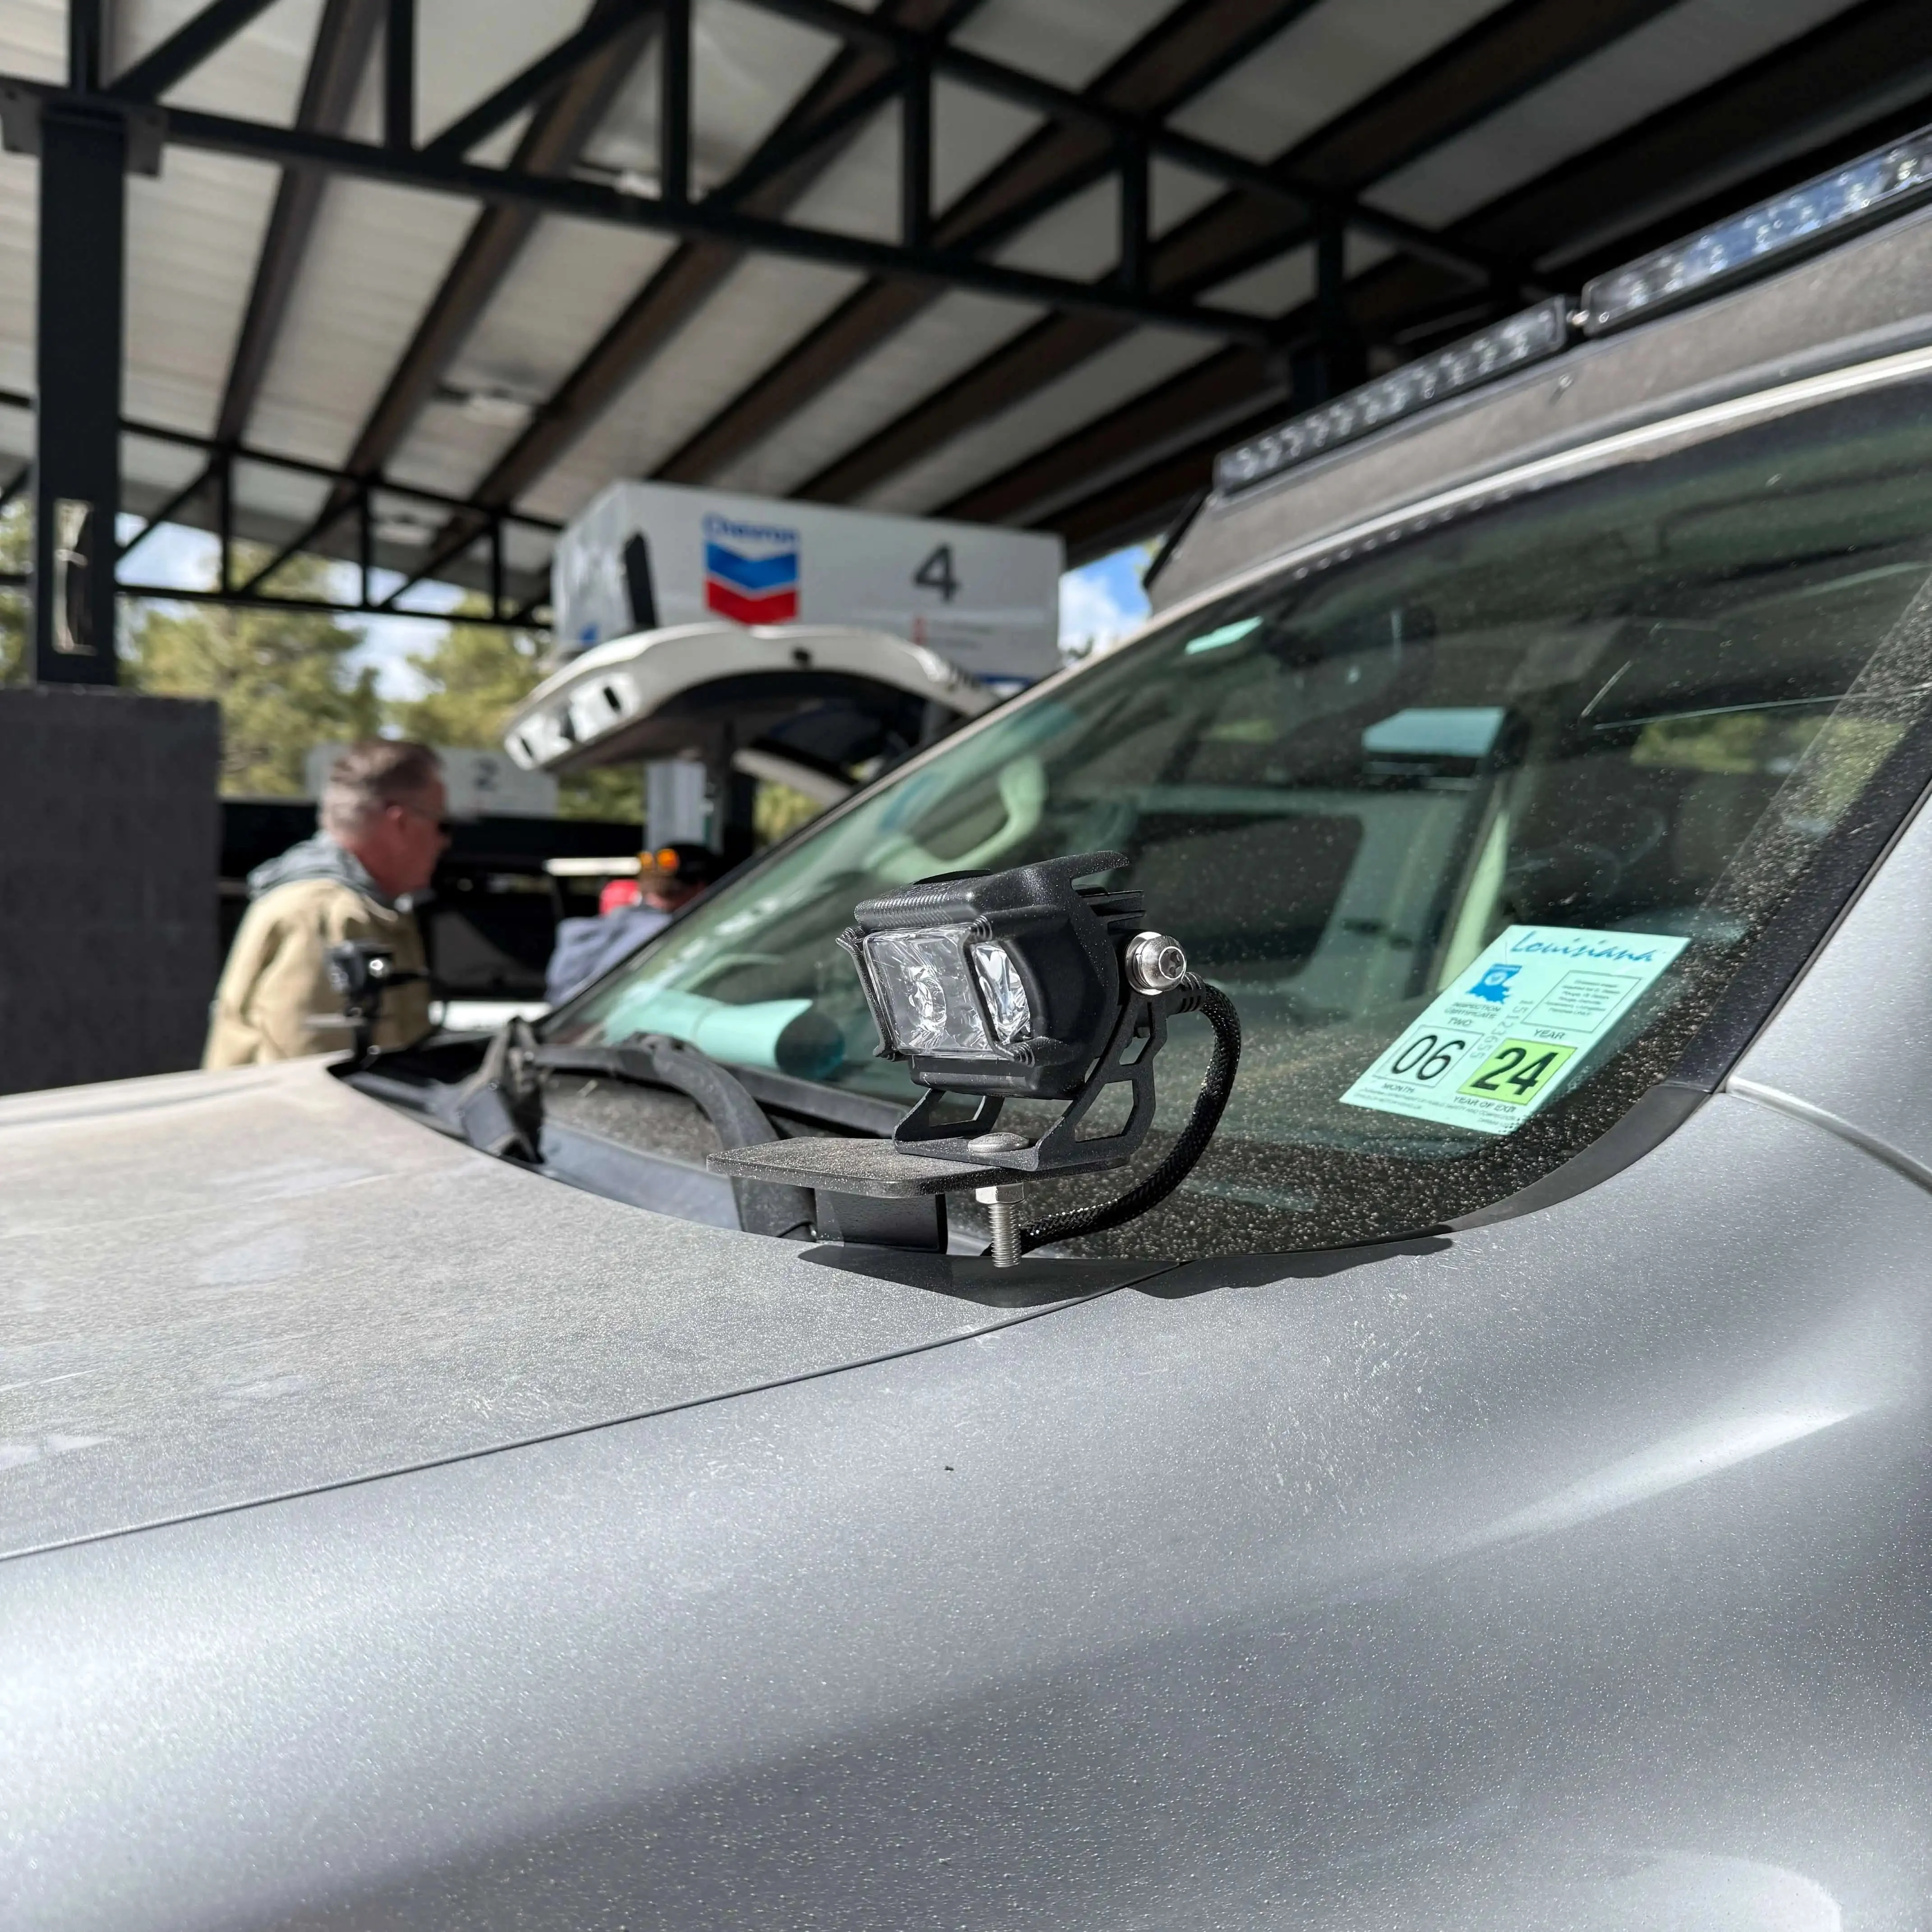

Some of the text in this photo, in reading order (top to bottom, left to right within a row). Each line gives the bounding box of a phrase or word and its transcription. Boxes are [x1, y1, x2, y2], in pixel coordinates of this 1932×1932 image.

[913, 543, 964, 603] 4
[1510, 931, 1657, 962] Louisiana
[1447, 1017, 1472, 1026] TWO
[1534, 1029, 1565, 1039] YEAR
[1392, 1035, 1465, 1080] 06
[1469, 1047, 1558, 1095] 24
[1381, 1083, 1416, 1093] MONTH
[1453, 1096, 1480, 1106] YEAR
